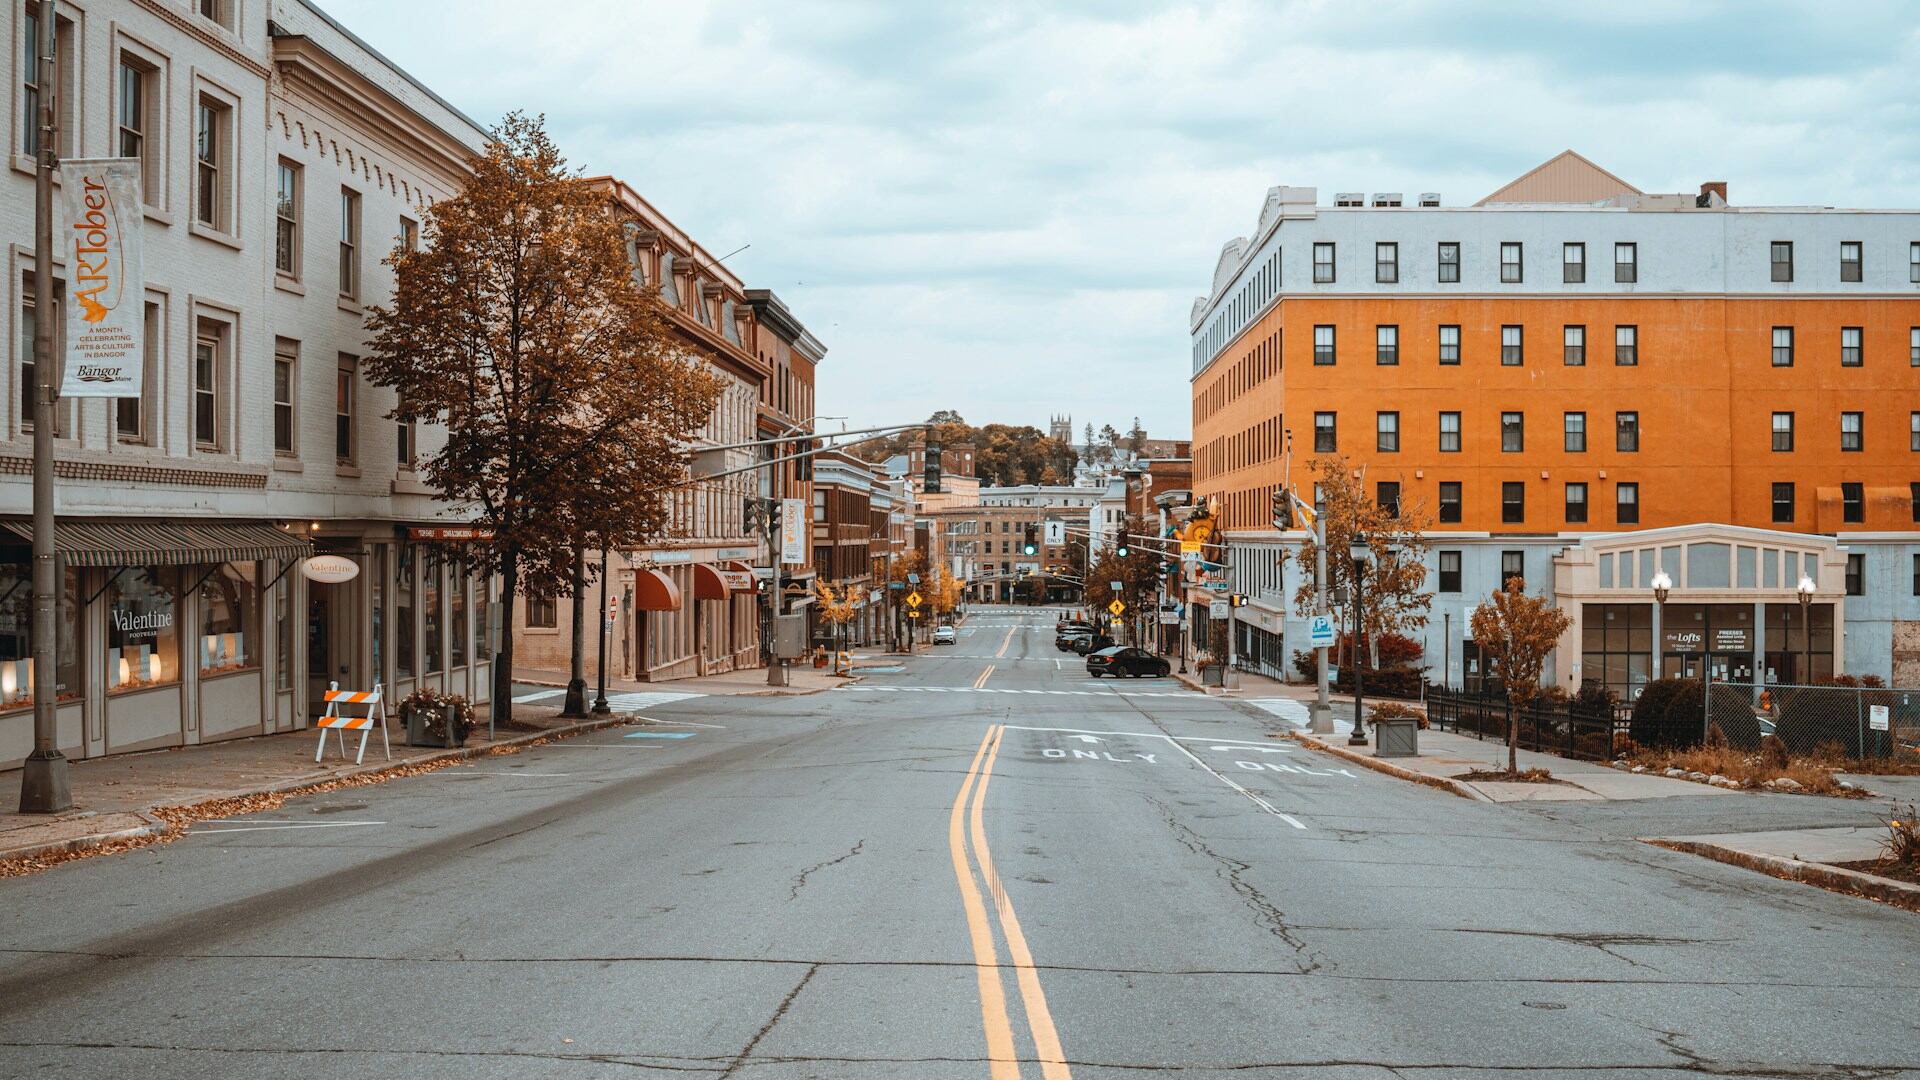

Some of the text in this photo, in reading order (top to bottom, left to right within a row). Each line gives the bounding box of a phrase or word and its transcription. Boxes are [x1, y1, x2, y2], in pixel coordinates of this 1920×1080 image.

[74, 176, 108, 305] ARTober
[77, 365, 122, 378] Bangor
[310, 563, 353, 573] Valentine
[113, 609, 172, 631] Valentine
[129, 631, 157, 639] FOOTWEAR
[1678, 633, 1701, 643] Lofts
[1043, 749, 1157, 764] ONLY
[1236, 760, 1357, 778] ONLY
